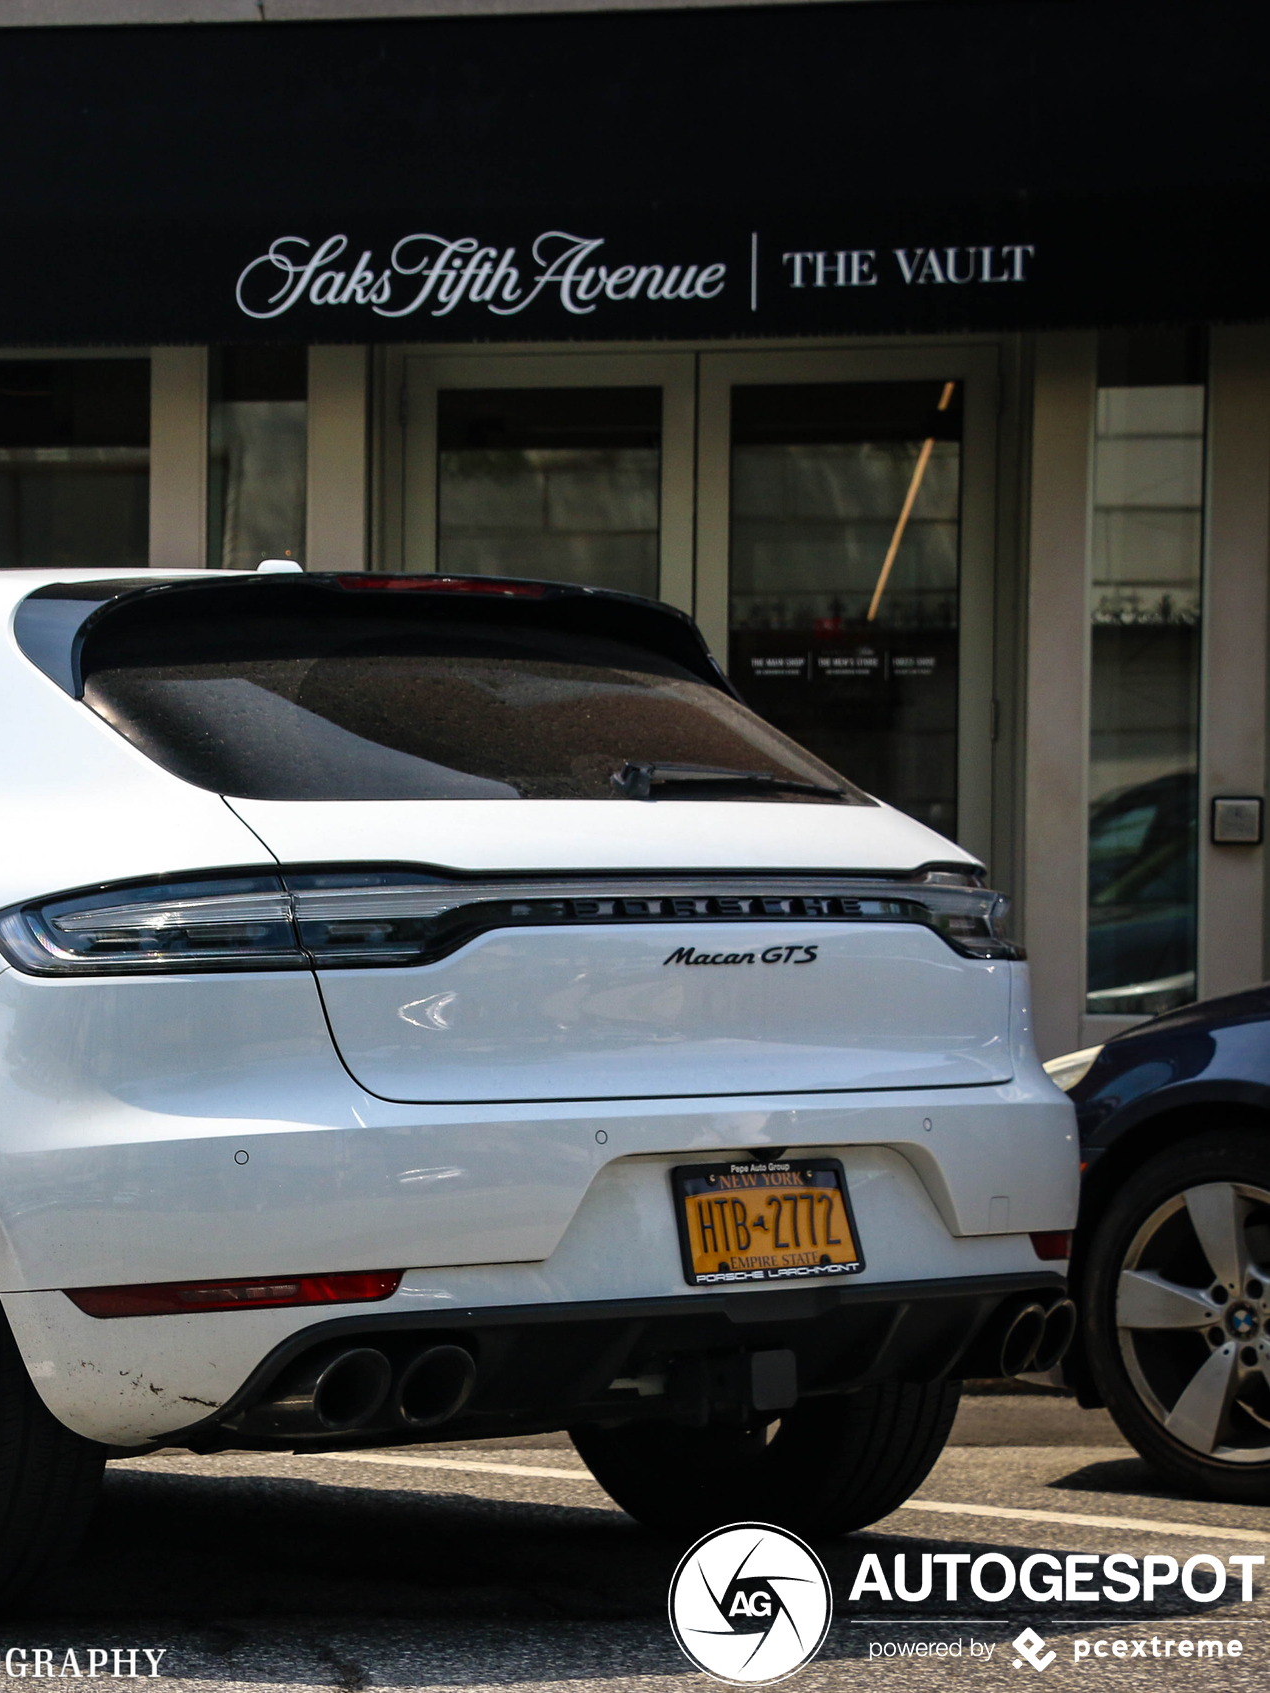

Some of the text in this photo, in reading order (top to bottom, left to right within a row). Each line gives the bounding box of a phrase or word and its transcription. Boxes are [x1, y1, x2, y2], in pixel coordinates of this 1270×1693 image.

[236, 230, 726, 319] Saks Fifth Avenue
[783, 245, 1035, 288] THE VAULT
[571, 896, 863, 917] PORSCHE
[663, 944, 819, 966] Macan GTS
[730, 1162, 790, 1174] Pepe Auto Group
[720, 1171, 805, 1189] NEW YORK
[697, 1194, 841, 1253] HTB 2772
[730, 1251, 820, 1270] EMPIRE STATE
[696, 1262, 860, 1283] PORSCHE LARCHMONT
